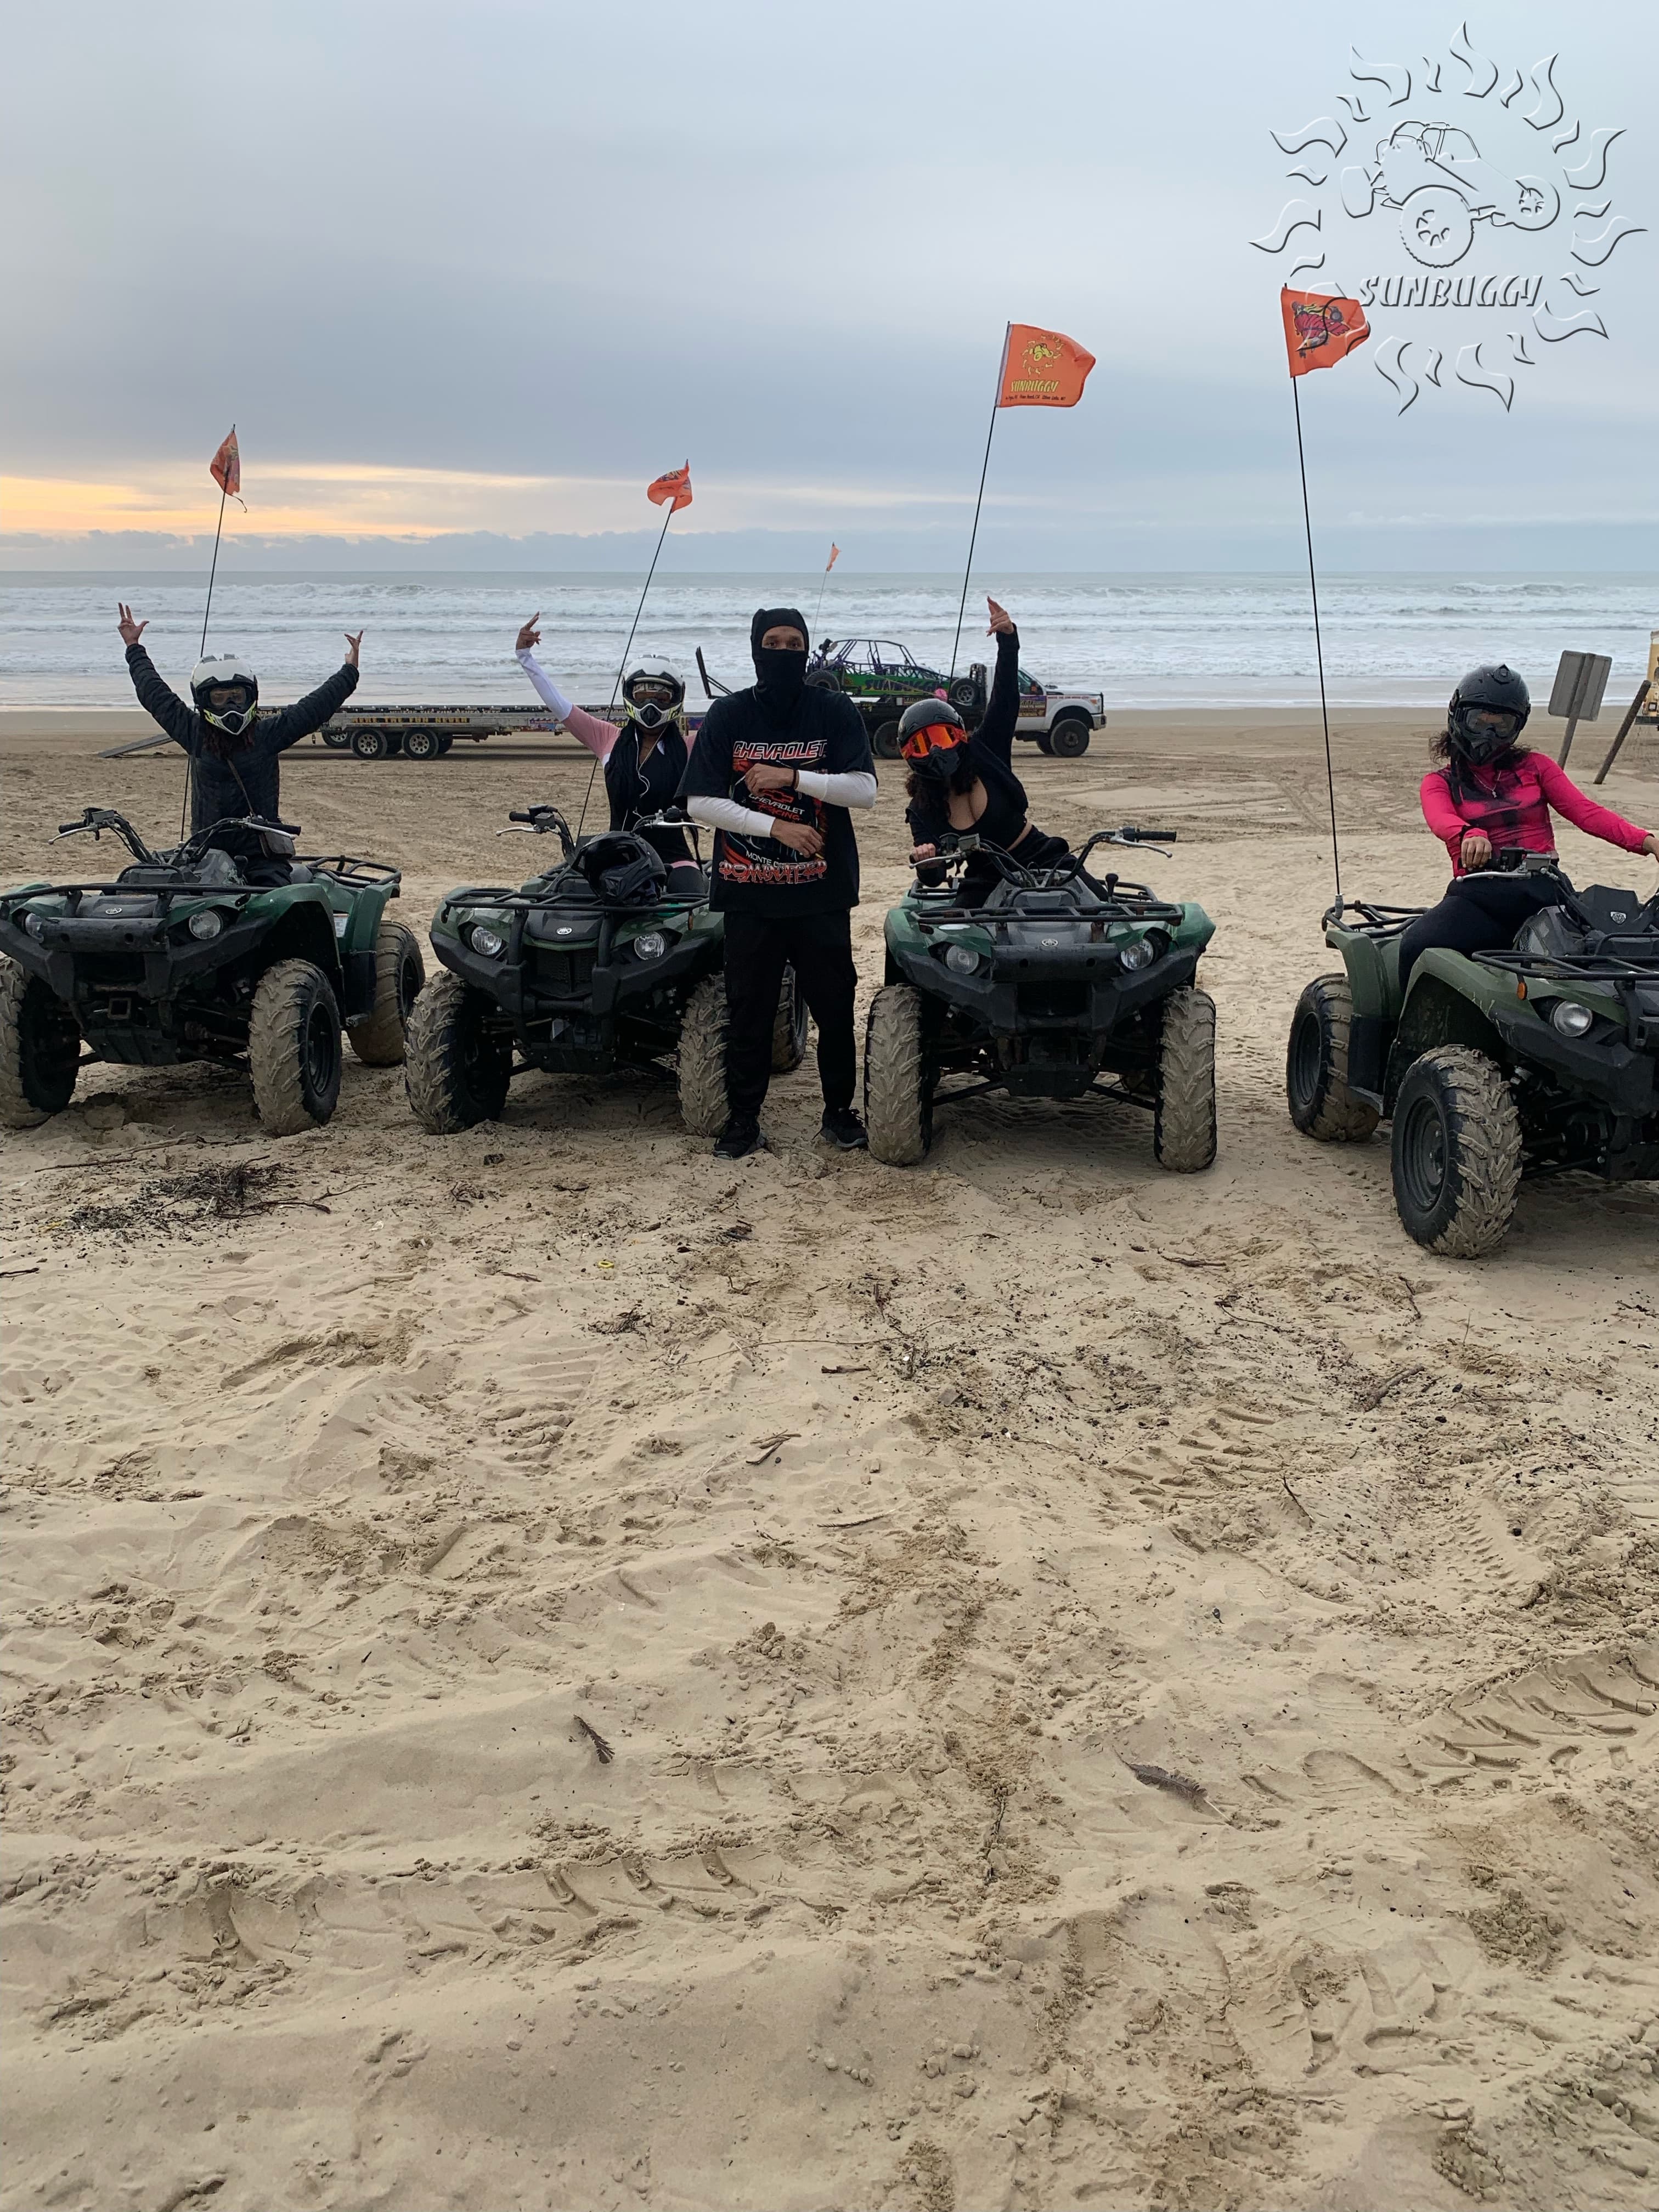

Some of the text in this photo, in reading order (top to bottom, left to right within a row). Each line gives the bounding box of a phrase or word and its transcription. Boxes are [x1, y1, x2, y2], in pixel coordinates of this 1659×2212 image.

[1010, 380, 1059, 392] SUNBUGGY
[733, 740, 827, 760] CHEVROLET
[748, 793, 805, 815] CHEVROLET
[746, 850, 772, 865] MONTE
